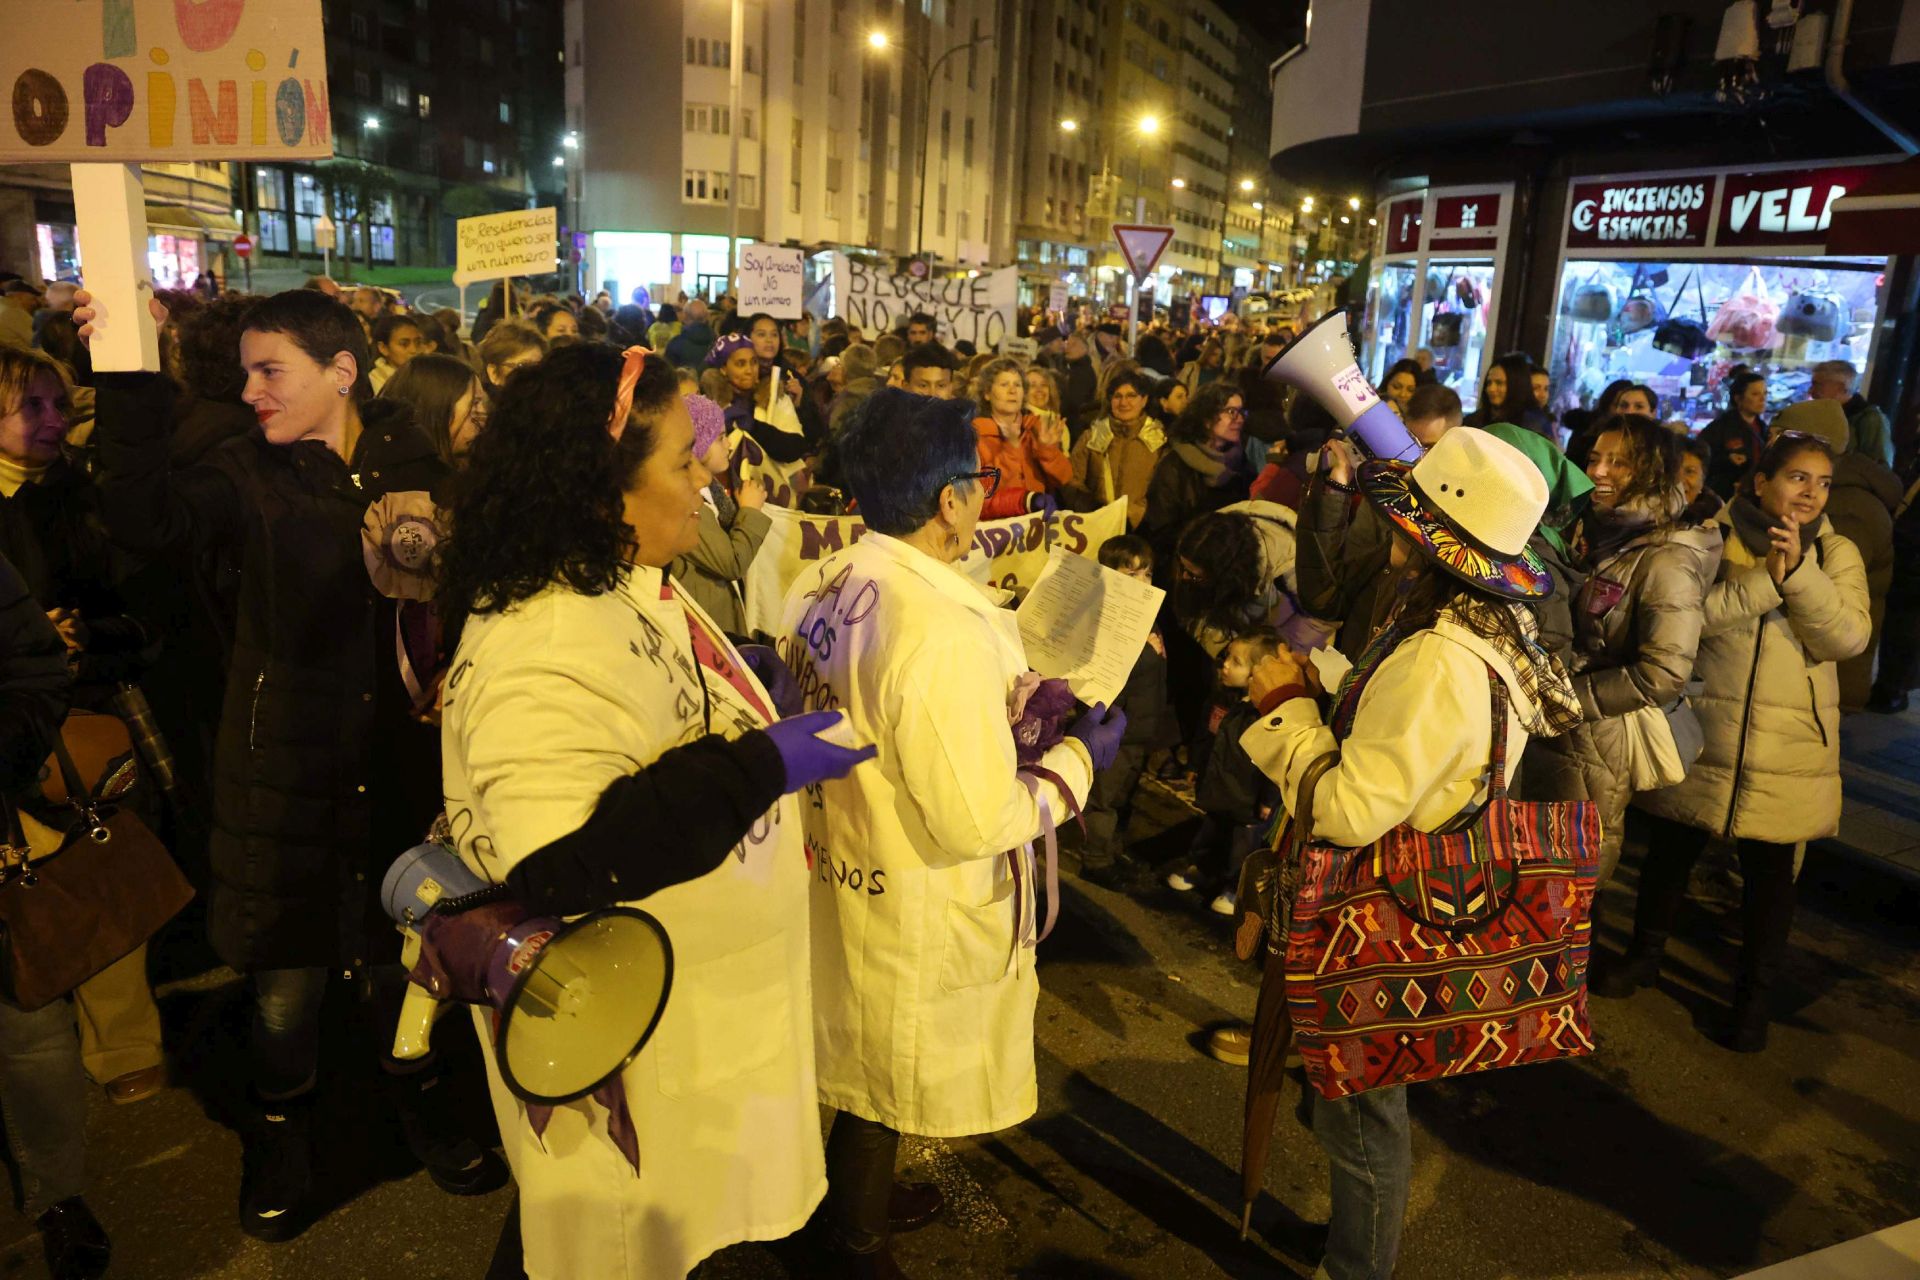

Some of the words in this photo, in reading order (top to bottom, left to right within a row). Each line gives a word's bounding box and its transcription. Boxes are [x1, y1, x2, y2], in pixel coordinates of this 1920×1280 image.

[1600, 183, 1705, 213] INCIENSOS
[743, 251, 763, 278] Soy
[849, 260, 993, 309] BLOQUE
[744, 296, 760, 306] un
[846, 296, 890, 332] NO
[904, 301, 1006, 349] MXTO
